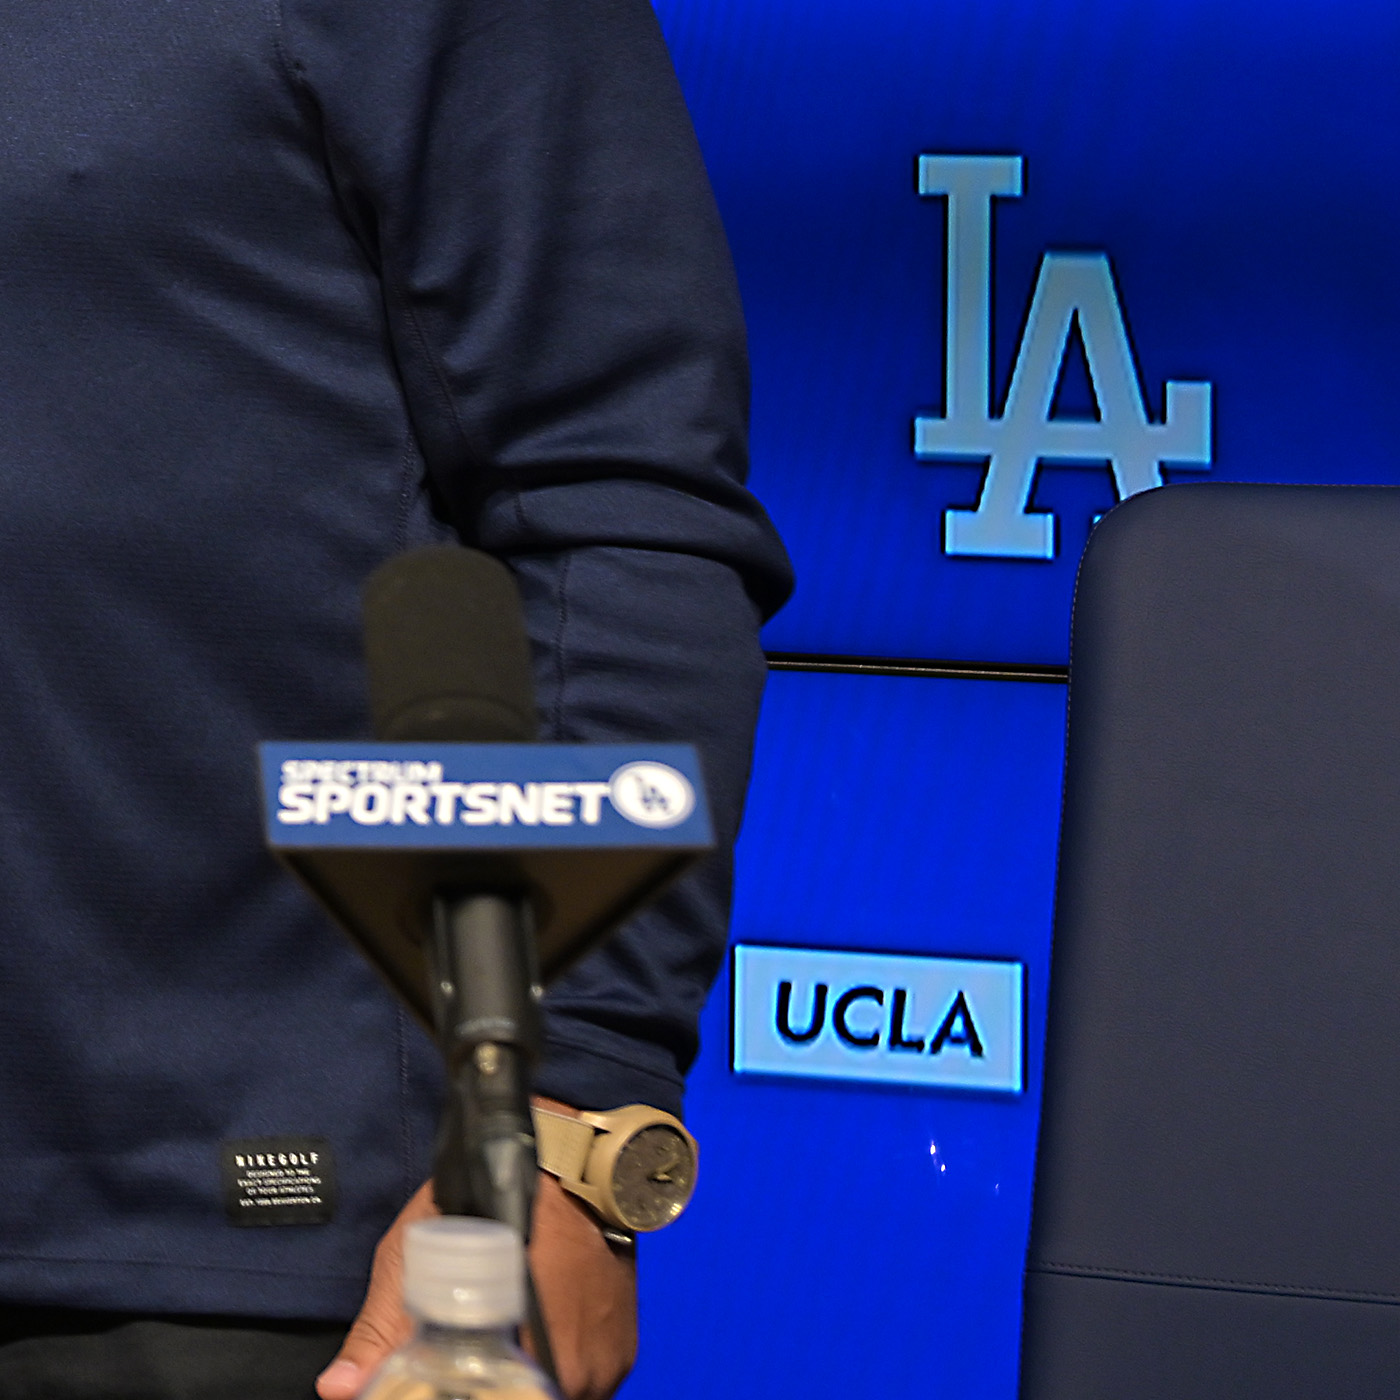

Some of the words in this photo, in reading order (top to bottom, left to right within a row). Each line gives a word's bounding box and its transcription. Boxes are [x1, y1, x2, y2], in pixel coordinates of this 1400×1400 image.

[914, 153, 1212, 559] LA
[281, 760, 444, 784] SPECTRUM
[277, 780, 611, 826] SPORTSNET
[774, 981, 985, 1058] UCLA
